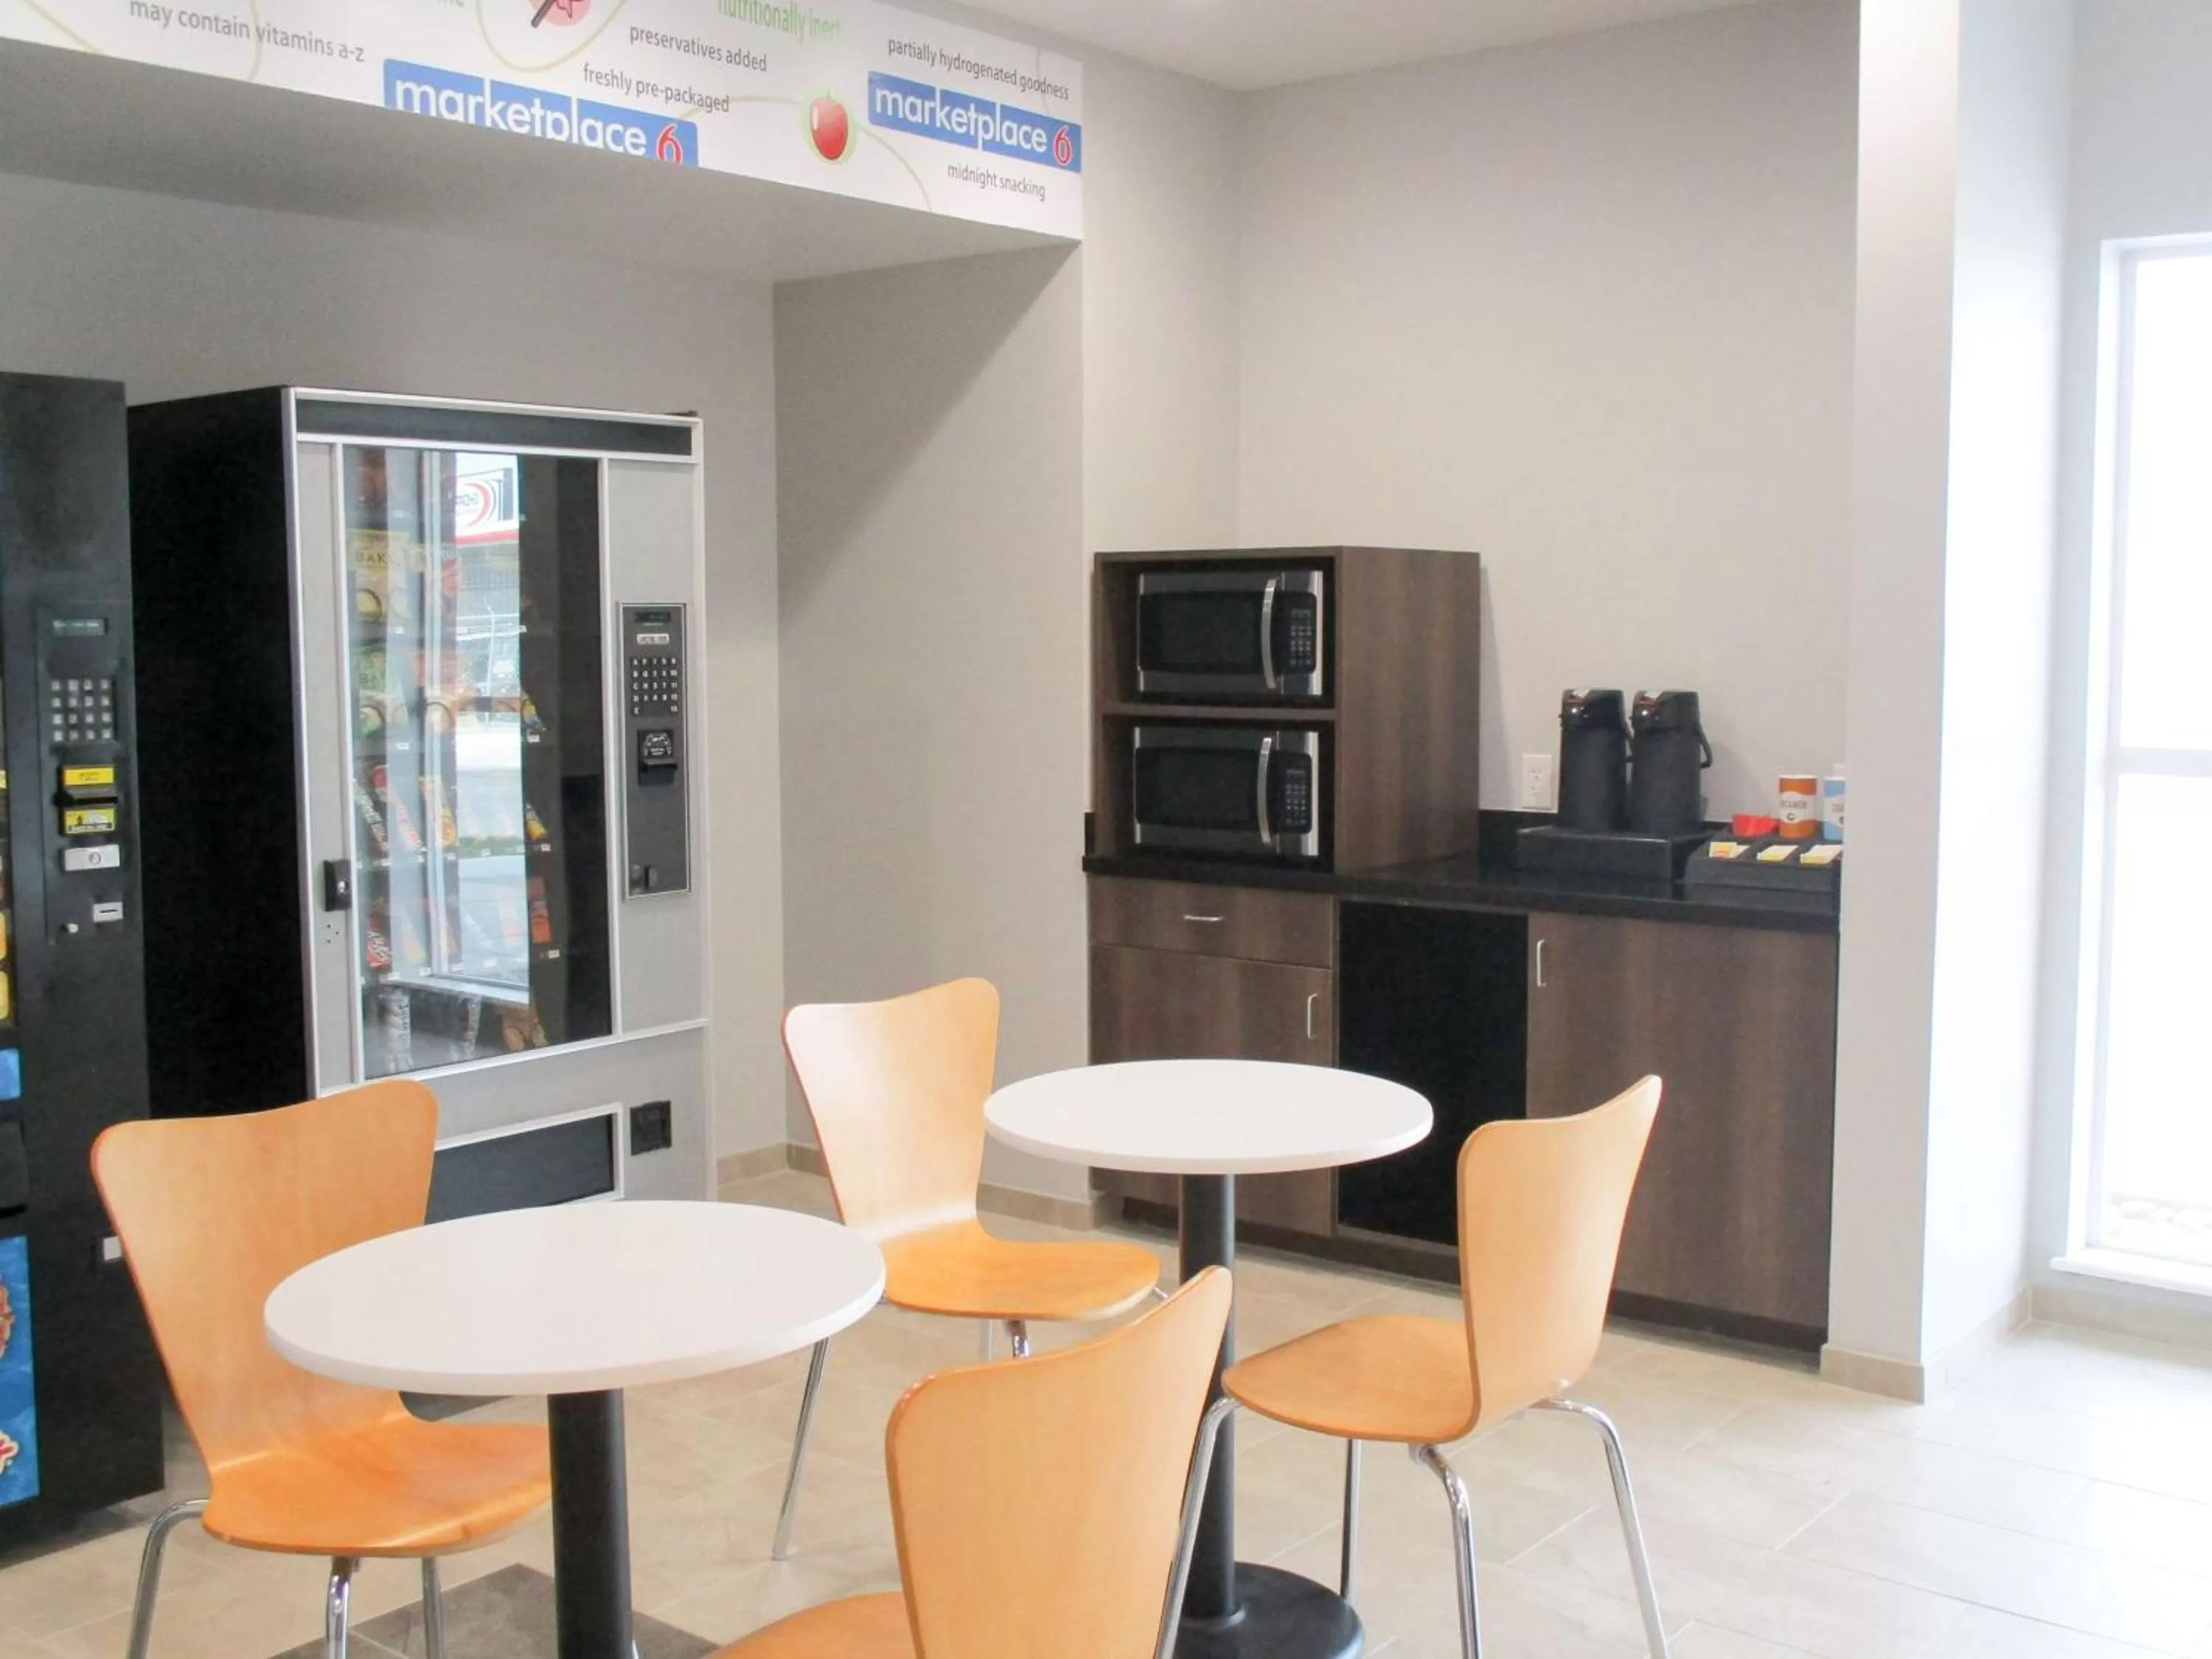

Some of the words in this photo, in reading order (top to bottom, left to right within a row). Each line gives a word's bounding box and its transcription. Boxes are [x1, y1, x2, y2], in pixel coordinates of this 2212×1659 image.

[130, 0, 173, 29] may
[178, 10, 251, 39] contain
[255, 22, 334, 57] vitamins
[338, 43, 366, 63] a-z
[630, 26, 723, 63] preservatives
[726, 48, 768, 72] added
[582, 63, 633, 96] freshly
[636, 78, 730, 114] pre-packaged
[888, 38, 937, 67] partially
[939, 48, 1018, 80] hydrogenated
[1020, 74, 1071, 100] goodness
[395, 77, 647, 156] marketplace
[875, 87, 1048, 153] marketplace
[1053, 125, 1074, 166] 6
[947, 163, 998, 189] midnight
[999, 177, 1046, 202] snacking
